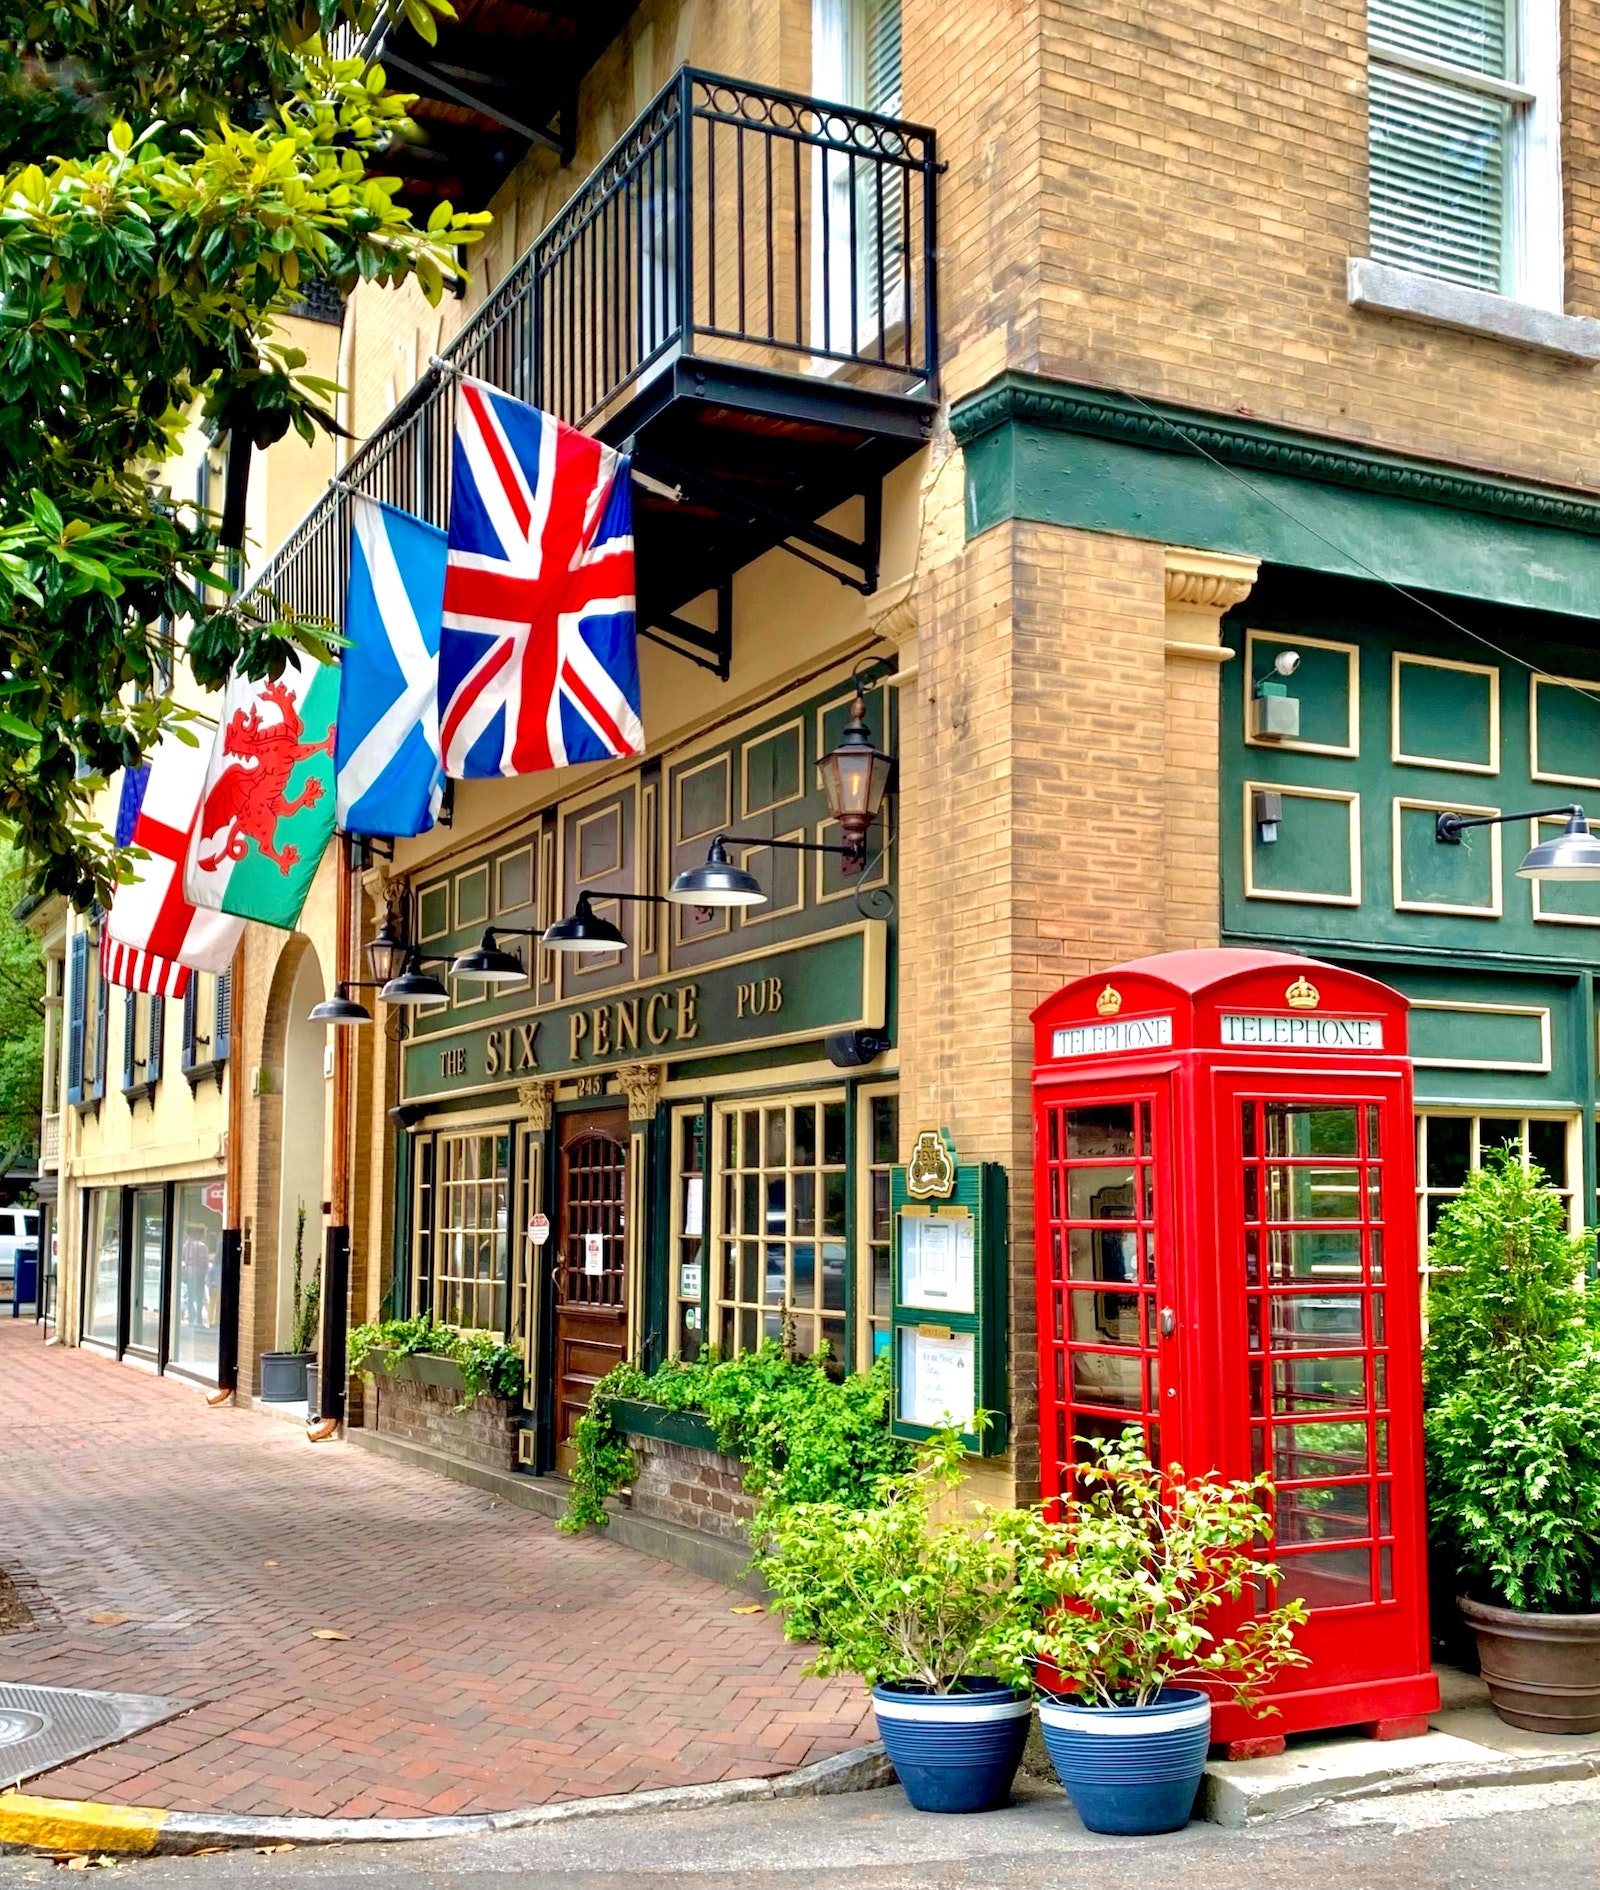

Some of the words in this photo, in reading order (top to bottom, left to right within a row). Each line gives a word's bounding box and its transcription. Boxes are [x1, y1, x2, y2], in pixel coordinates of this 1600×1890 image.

[440, 1047, 466, 1078] THE
[485, 1021, 541, 1075] SIX
[568, 984, 699, 1060] PENCE
[737, 977, 783, 1019] PUB
[1057, 1018, 1168, 1055] TELEPHONE
[1223, 1016, 1374, 1046] TELEPHONE
[577, 1077, 602, 1097] 245
[922, 1136, 936, 1148] SIX
[916, 1150, 941, 1162] PENCE
